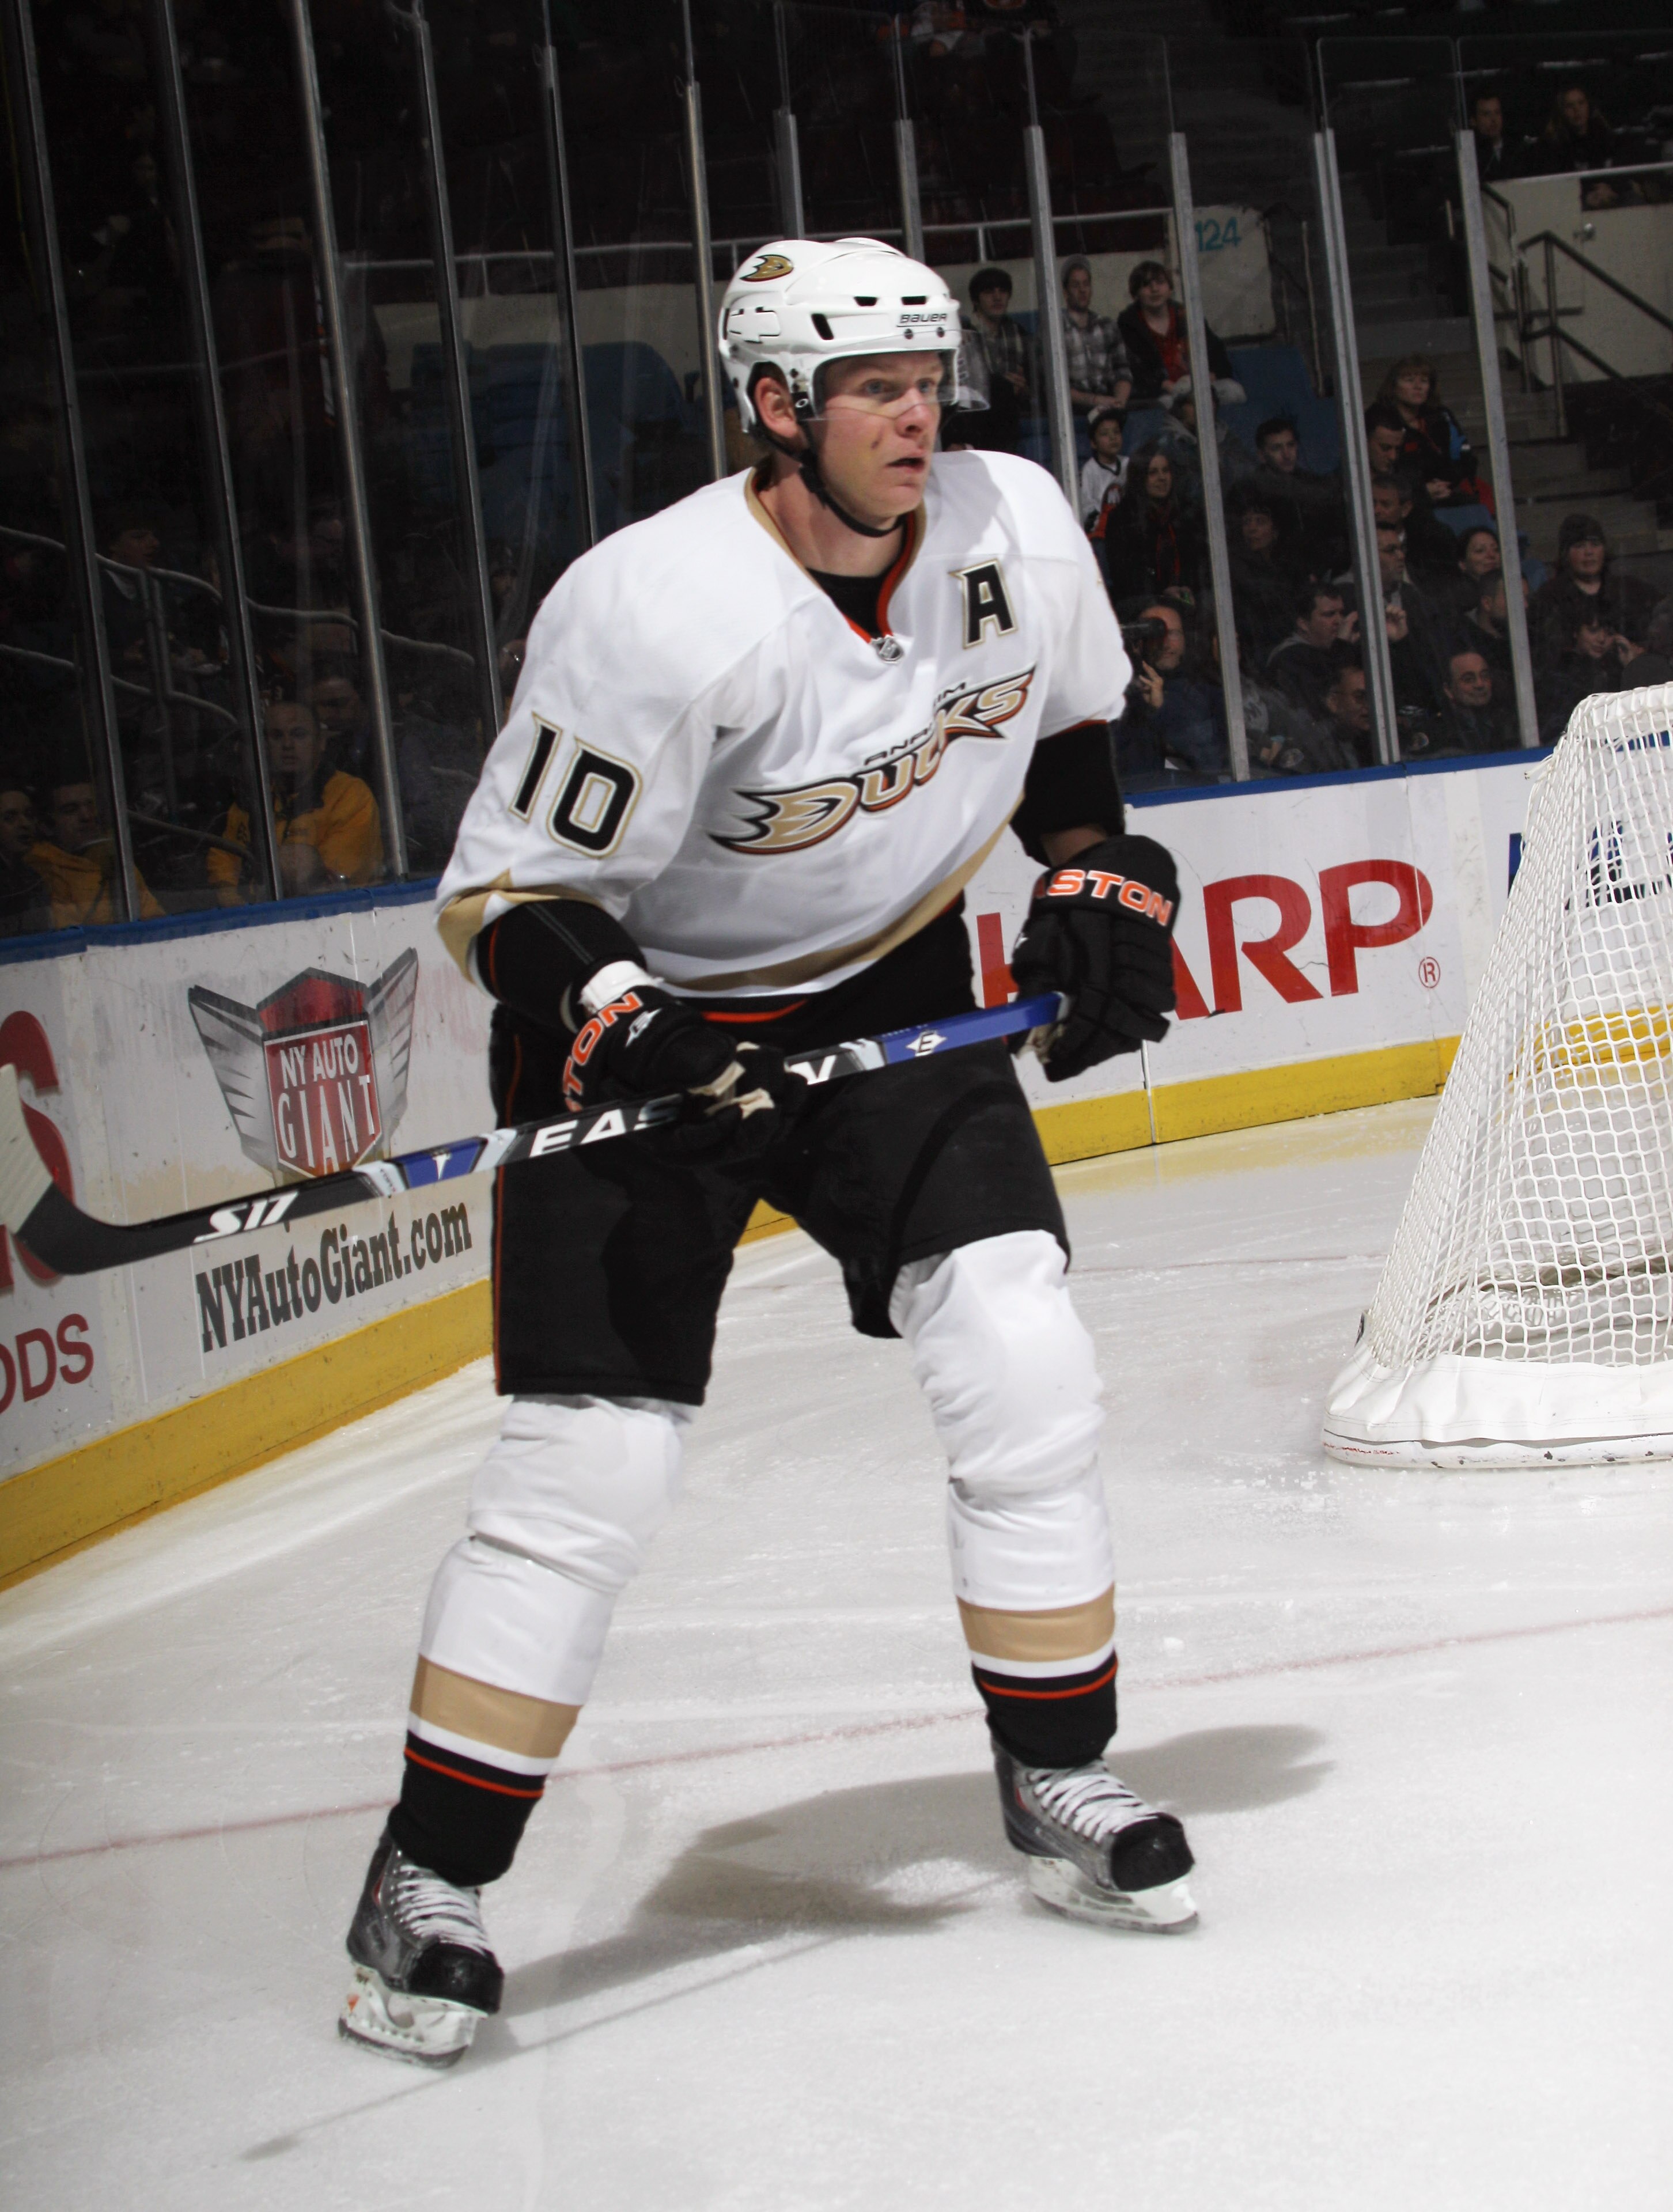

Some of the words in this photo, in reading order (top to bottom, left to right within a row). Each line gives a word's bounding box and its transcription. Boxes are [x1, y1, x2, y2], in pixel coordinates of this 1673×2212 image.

[1195, 217, 1241, 252] 124
[949, 558, 1018, 649] A
[508, 711, 643, 859] 10
[280, 1046, 305, 1089] NY
[313, 1034, 358, 1082] AUTO
[278, 1074, 374, 1175] GIANT
[193, 1190, 300, 1244] S17
[196, 1202, 472, 1353] NYAutoGiant.com
